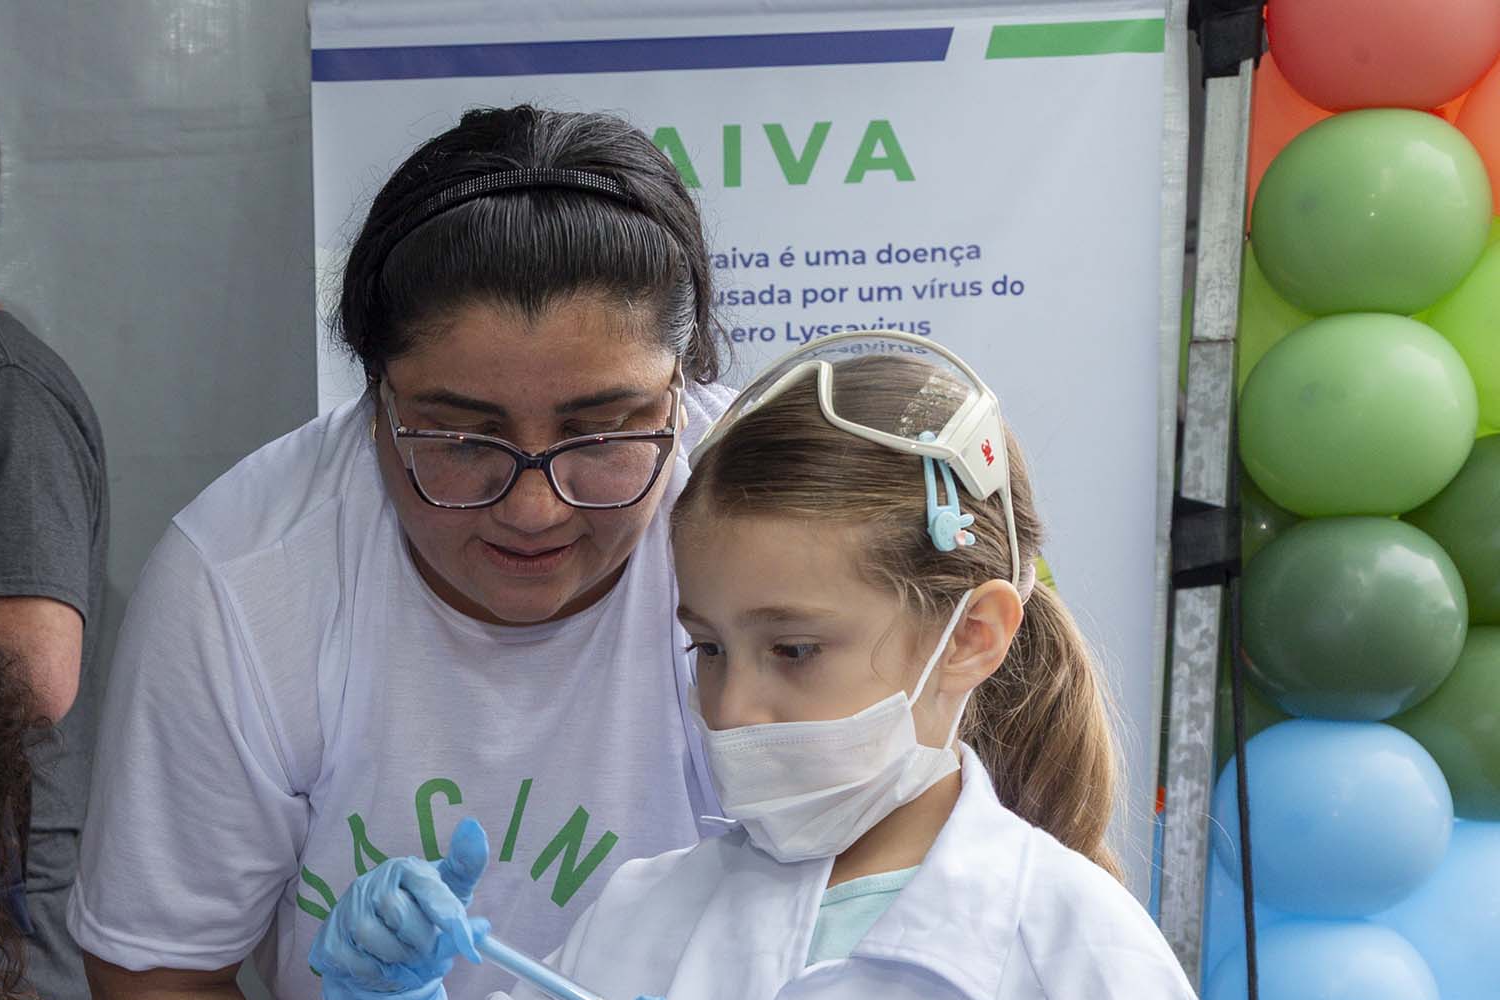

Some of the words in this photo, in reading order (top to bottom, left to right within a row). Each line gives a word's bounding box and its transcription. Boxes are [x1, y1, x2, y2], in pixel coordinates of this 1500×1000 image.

[779, 246, 795, 267] é
[805, 249, 867, 266] uma
[876, 243, 981, 267] doença
[802, 286, 848, 309] por
[858, 285, 903, 302] um
[912, 277, 982, 299] vírus
[991, 274, 1025, 296] do
